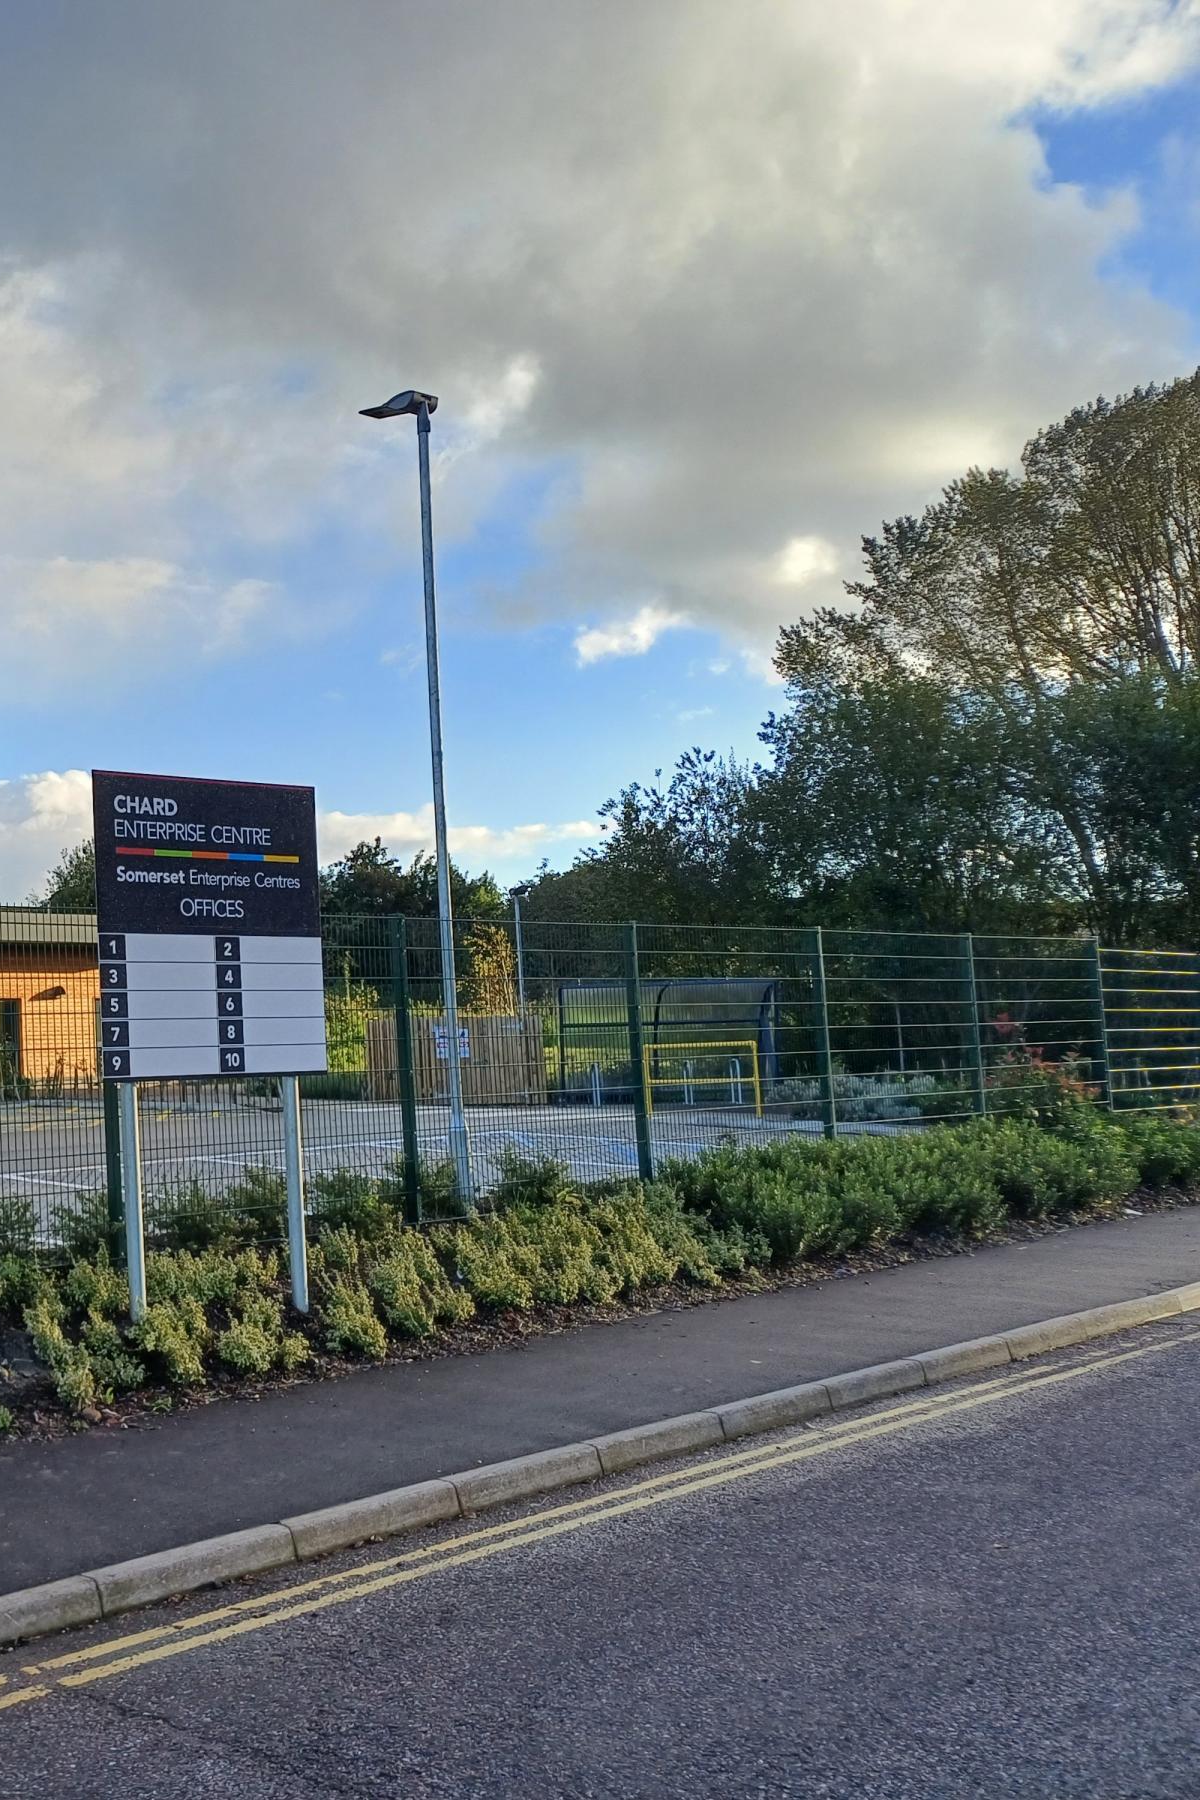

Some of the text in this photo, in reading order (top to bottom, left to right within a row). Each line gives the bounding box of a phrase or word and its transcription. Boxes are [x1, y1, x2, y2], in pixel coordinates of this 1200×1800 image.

[113, 795, 178, 816] CHARD
[114, 819, 271, 845] ENTERPRISE CENTRE
[116, 865, 300, 891] Somerset Enterprise Centres
[180, 898, 244, 918] OFFICES
[109, 940, 117, 954] 1
[224, 942, 232, 956] 2
[109, 969, 118, 983] 3
[225, 970, 233, 984] 4
[110, 998, 119, 1012] 5
[226, 998, 234, 1011] 6
[111, 1027, 120, 1041] 7
[227, 1025, 235, 1039] 8
[112, 1056, 121, 1071] 9
[225, 1053, 240, 1067] 10
